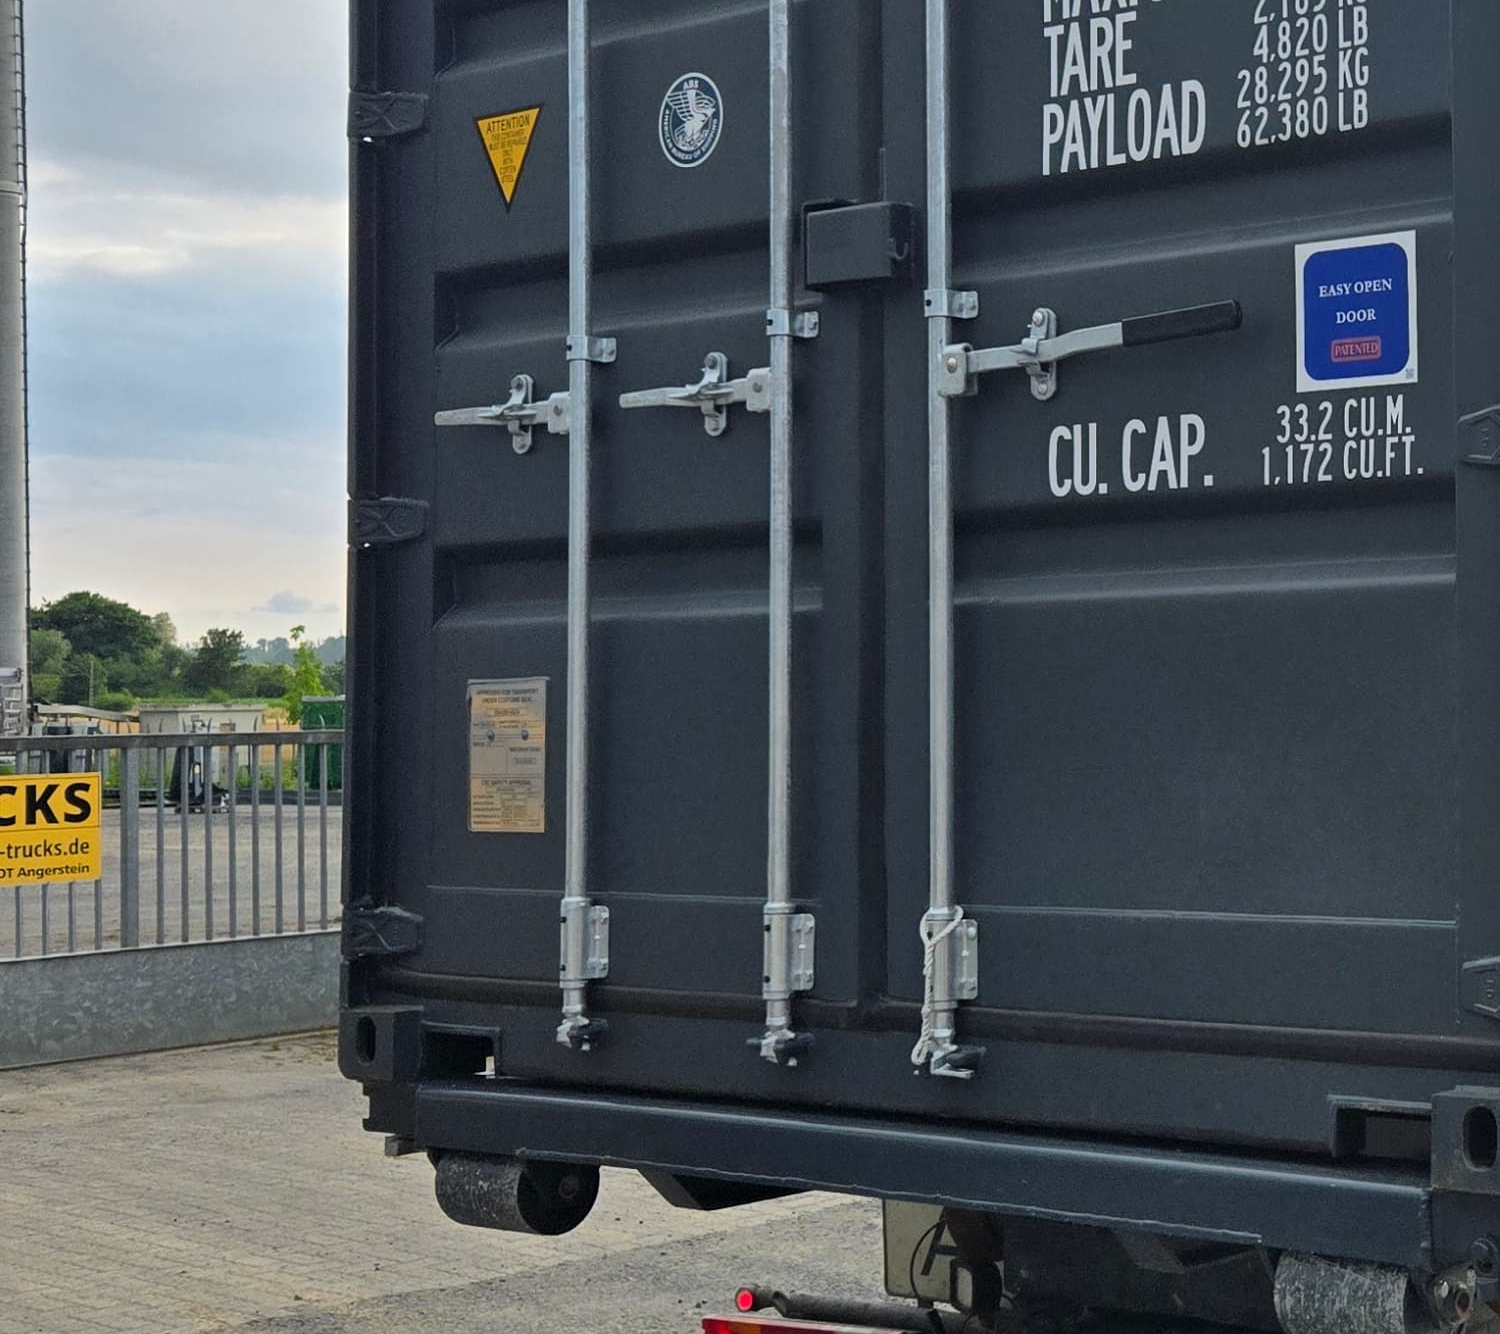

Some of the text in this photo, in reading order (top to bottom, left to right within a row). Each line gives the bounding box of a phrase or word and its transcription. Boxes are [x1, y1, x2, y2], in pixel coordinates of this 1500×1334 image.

[1253, 6, 1368, 63] 4,820 LB
[1043, 11, 1137, 98] TARE
[683, 79, 699, 91] ABS
[486, 114, 530, 134] ATTENTION
[1042, 47, 1369, 176] PAYLOAD 28,295 KG
[1237, 89, 1368, 148] 62,380 LB
[1318, 278, 1392, 297] EASY OPEN
[1336, 308, 1376, 324] DOOR
[1334, 342, 1379, 357] PATENTED
[1048, 422, 1108, 498] CU.
[1122, 413, 1214, 492] CAP.
[1276, 400, 1333, 443] 33.2
[1262, 444, 1333, 487] 1,172
[17, 863, 90, 879] Angerstein
